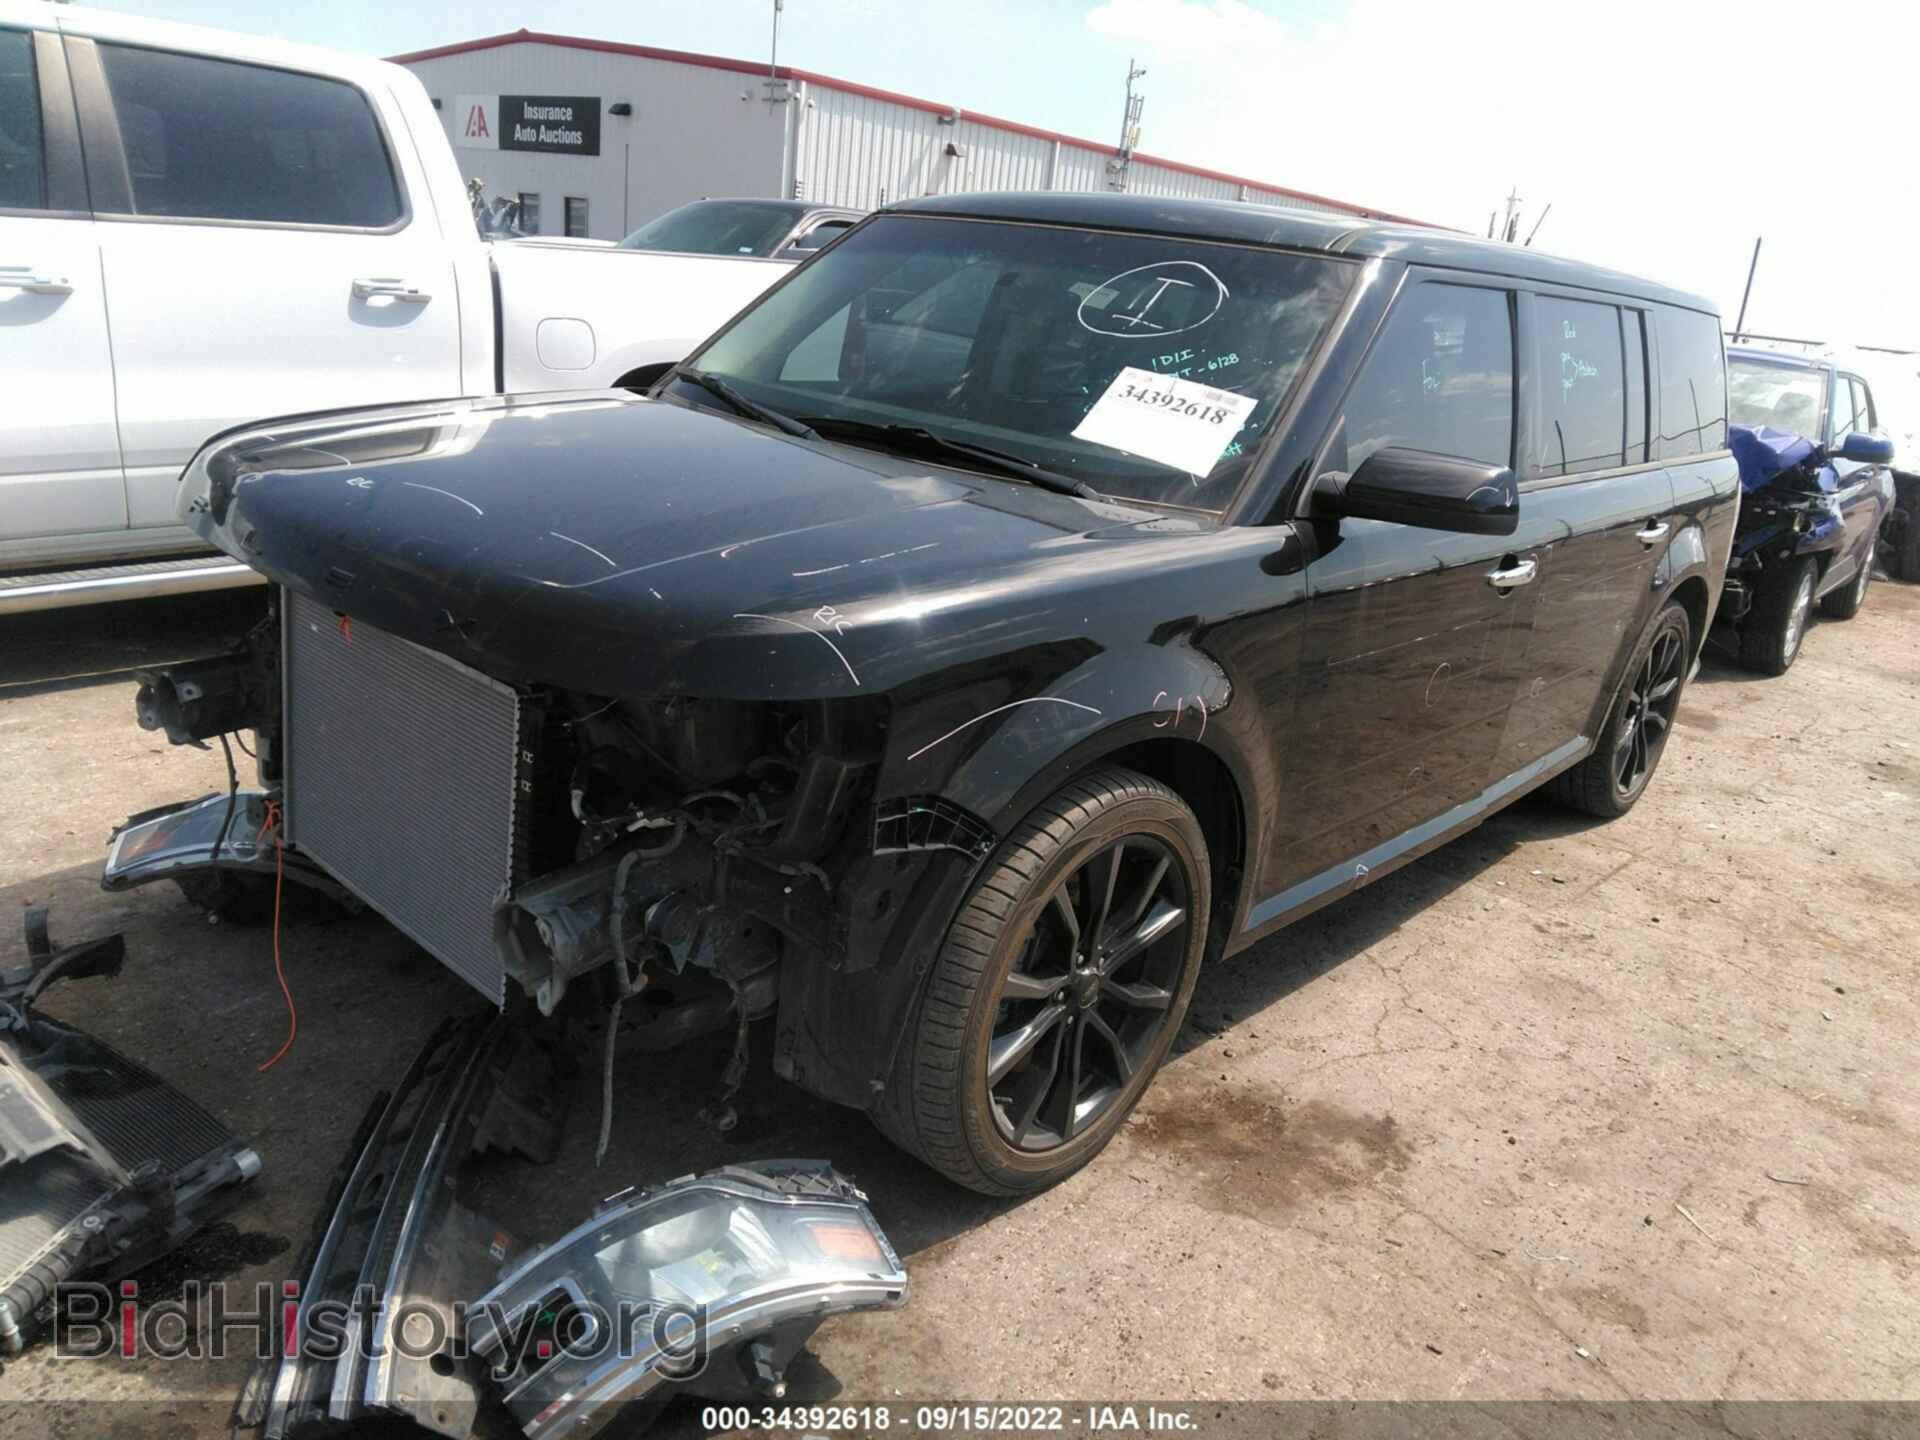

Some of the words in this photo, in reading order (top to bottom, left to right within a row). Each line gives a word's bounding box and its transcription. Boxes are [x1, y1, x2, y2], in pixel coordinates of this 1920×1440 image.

[523, 101, 573, 121] Insurance
[514, 123, 537, 143] Auto
[538, 124, 584, 145] Auctions
[1117, 384, 1228, 425] 34392618
